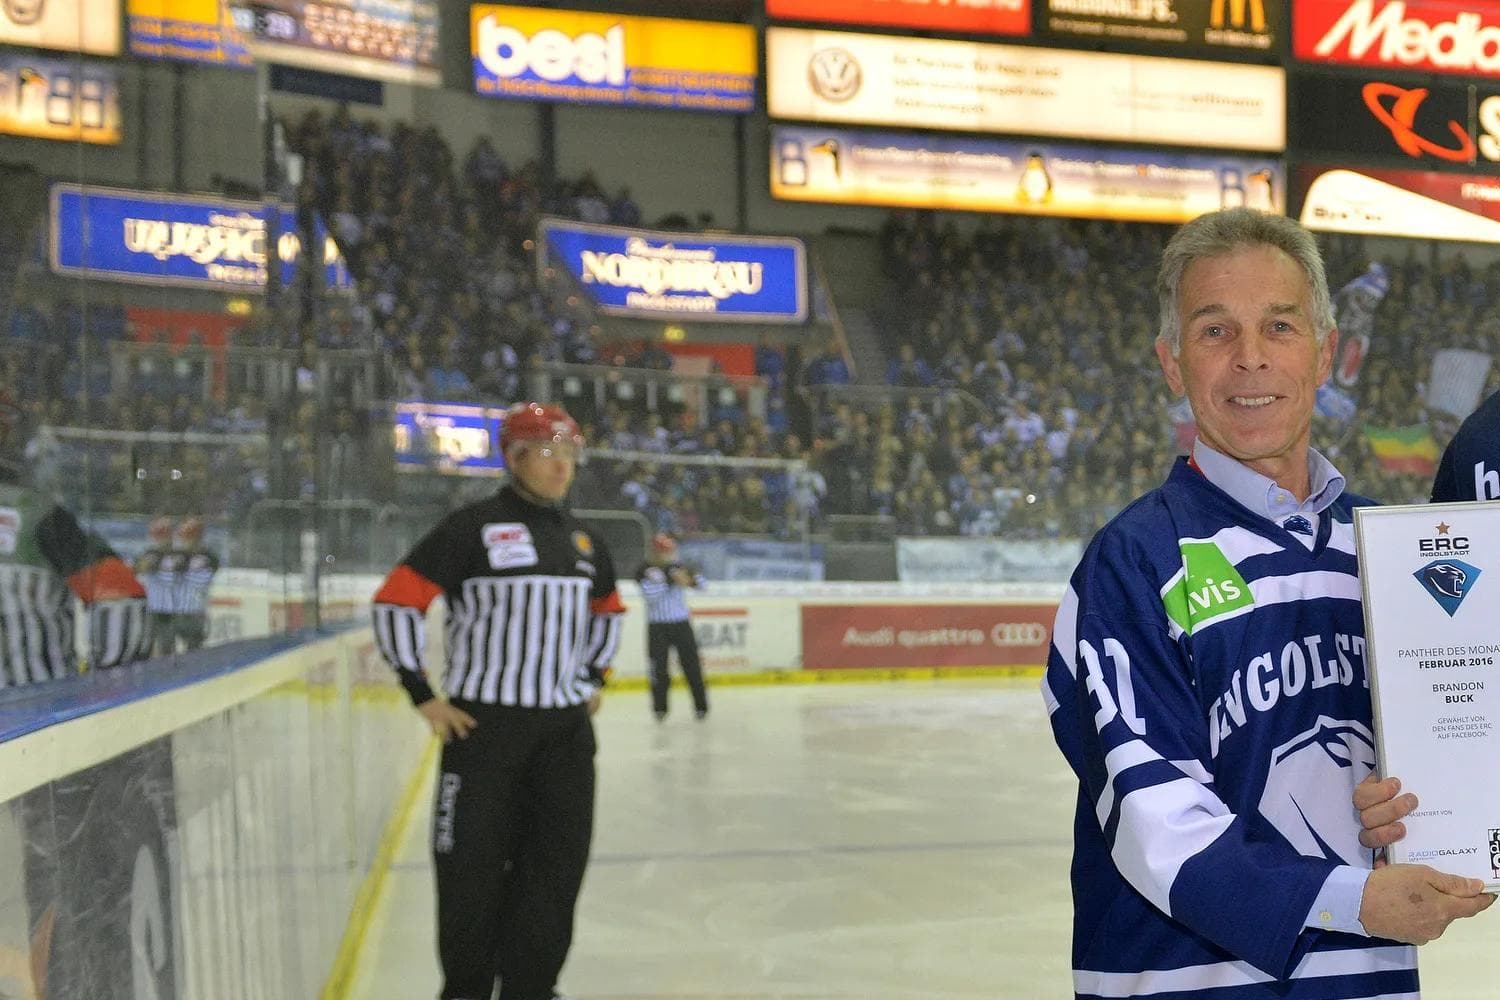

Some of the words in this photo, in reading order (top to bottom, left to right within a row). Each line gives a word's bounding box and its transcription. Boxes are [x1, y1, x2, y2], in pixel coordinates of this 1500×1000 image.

[1419, 537, 1470, 552] ERC
[1398, 648, 1445, 659] PANTHER
[1447, 646, 1466, 656] DES
[1419, 658, 1466, 669] FEBRUAR
[1469, 657, 1493, 666] 2016
[1432, 682, 1484, 692] BRANDON
[1445, 694, 1474, 703] BUCK
